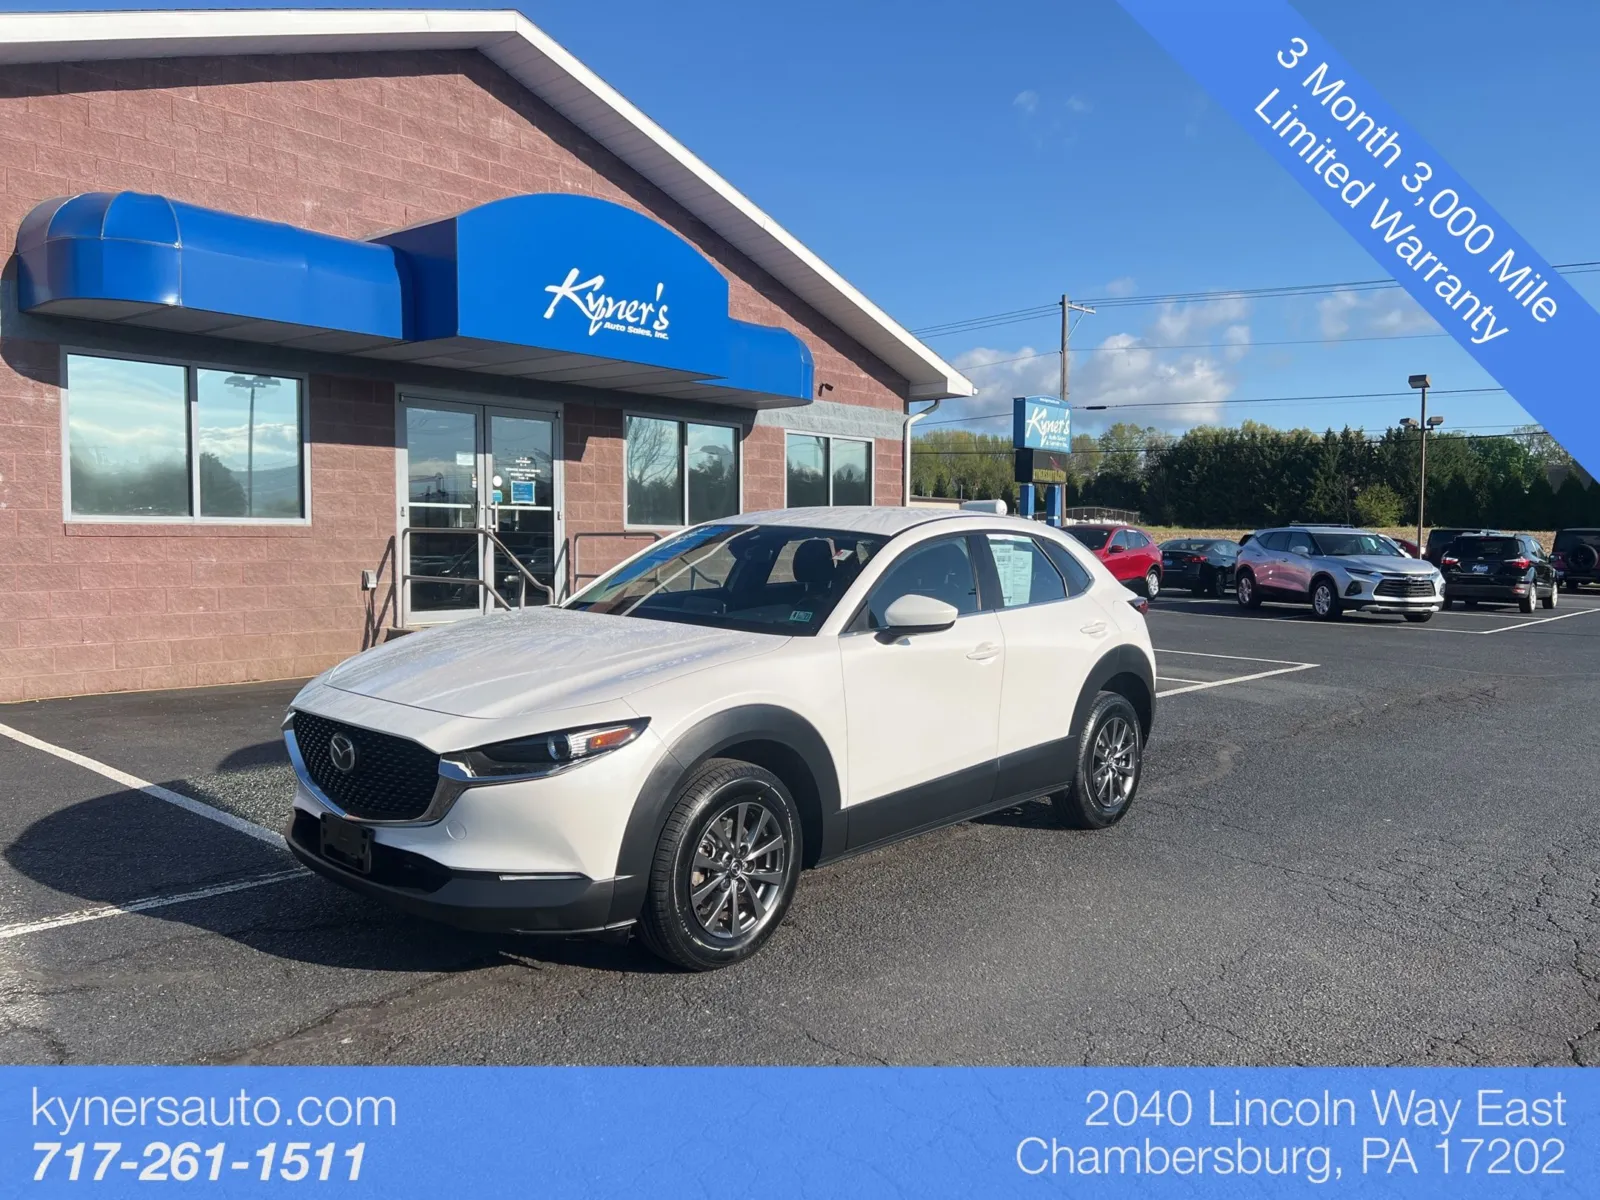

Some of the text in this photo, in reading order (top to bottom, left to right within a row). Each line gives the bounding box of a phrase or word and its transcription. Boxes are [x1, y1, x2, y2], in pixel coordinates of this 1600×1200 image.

[543, 267, 669, 336] Kyner's
[603, 322, 669, 340] Auto Sales, Inc.
[1025, 406, 1070, 447] Kyner's
